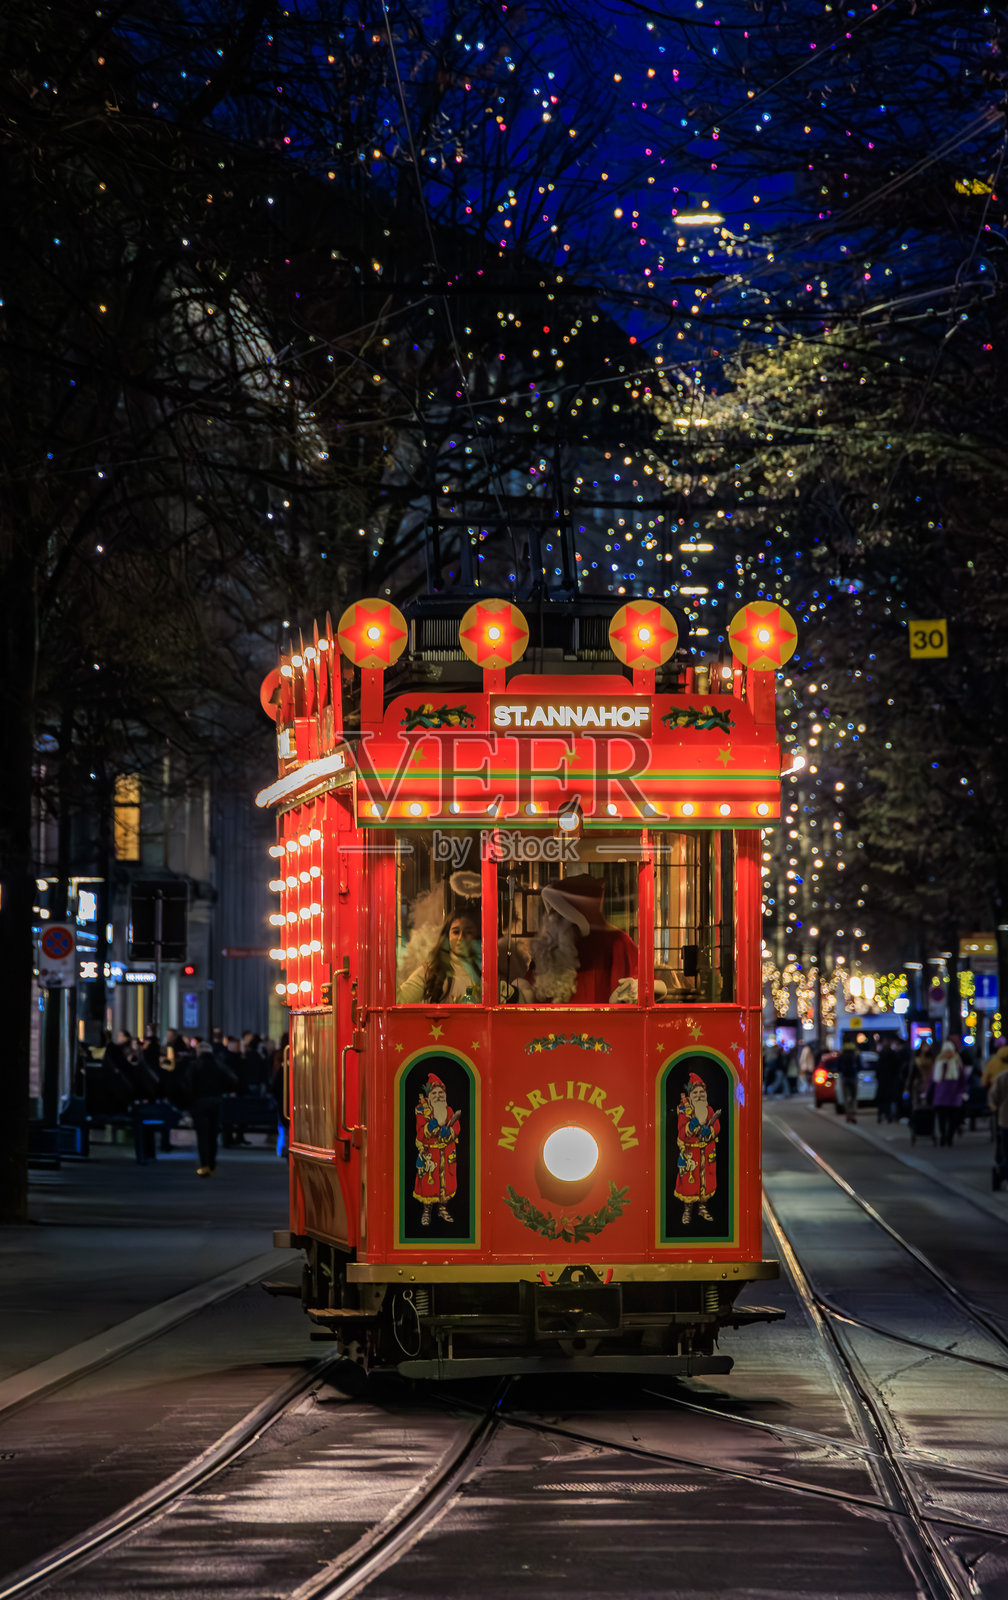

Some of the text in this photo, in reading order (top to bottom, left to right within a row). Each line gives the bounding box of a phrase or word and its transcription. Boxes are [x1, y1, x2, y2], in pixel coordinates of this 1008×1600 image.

[913, 630, 944, 650] 30
[493, 705, 650, 727] ST.ANNAHOF
[497, 1080, 640, 1151] MÄRLITRAM
